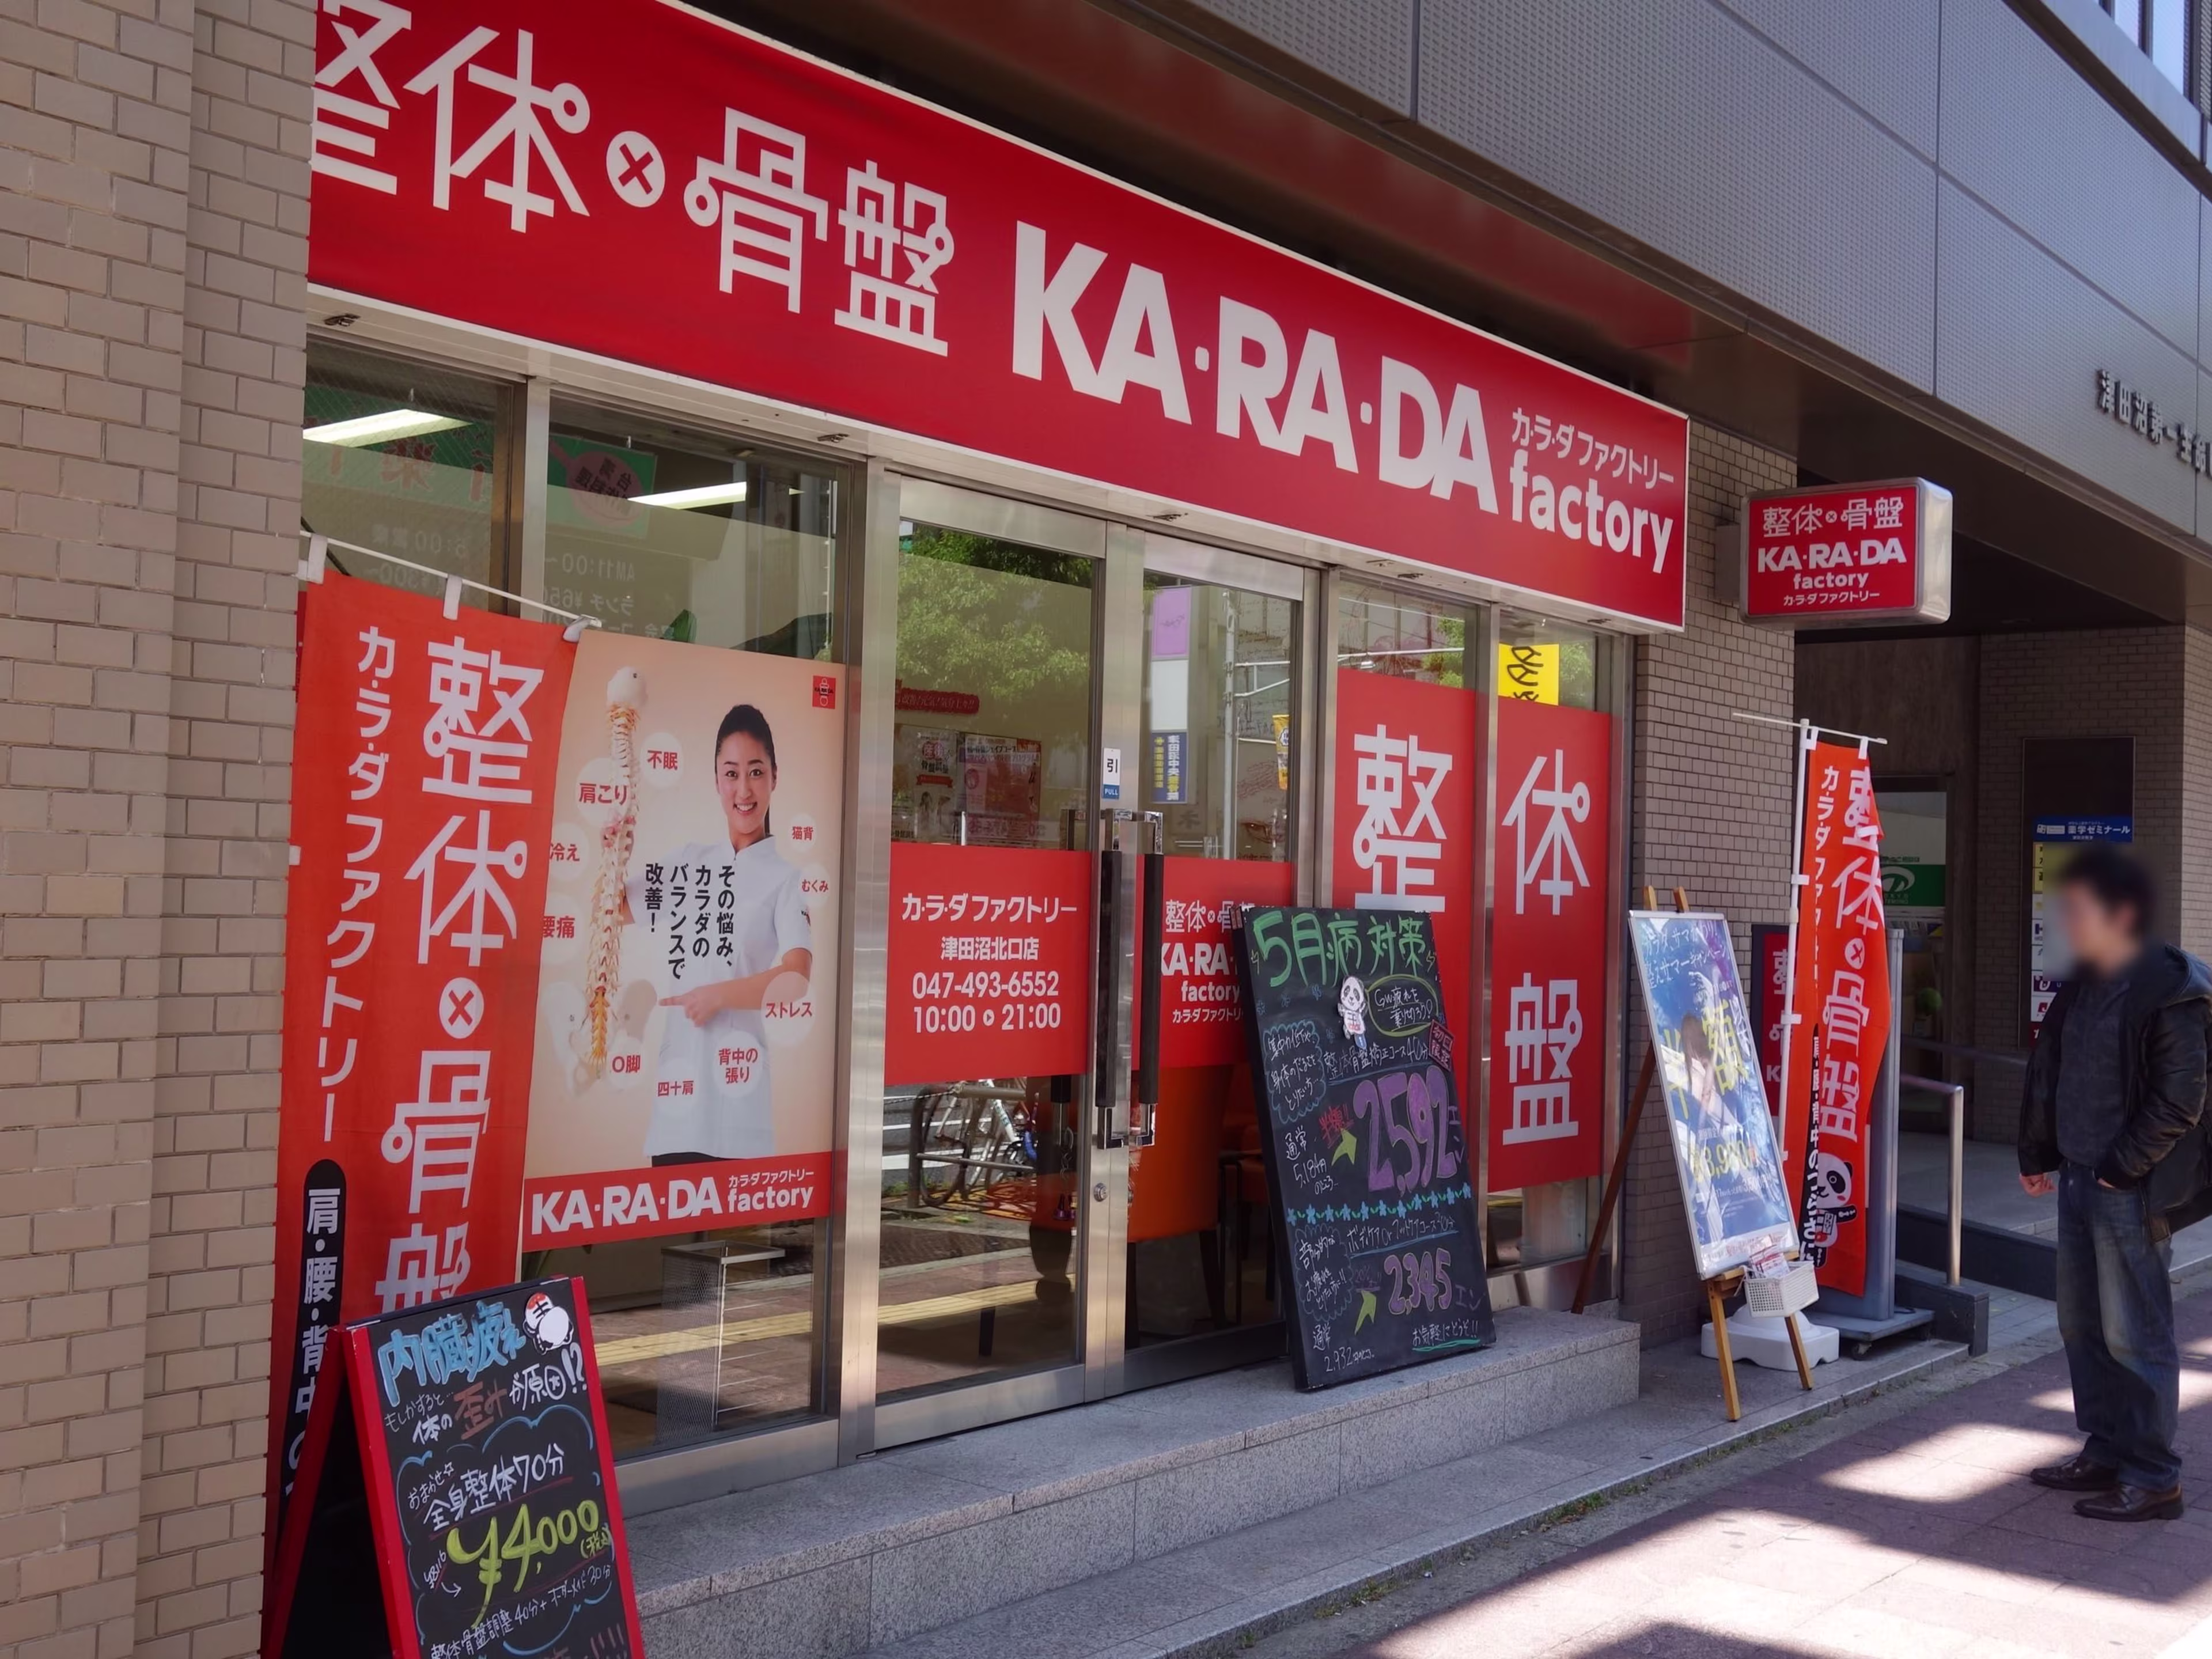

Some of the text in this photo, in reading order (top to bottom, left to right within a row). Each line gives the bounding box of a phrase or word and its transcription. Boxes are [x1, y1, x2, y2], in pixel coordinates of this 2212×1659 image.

[1510, 450, 1674, 574] factory
[1793, 572, 1869, 589] factory
[647, 750, 678, 770] 不眠
[1107, 758, 1118, 774] 引
[579, 783, 628, 804] 肩こり
[792, 826, 814, 841] 猫背
[550, 843, 580, 862] 冷え
[802, 879, 829, 893] むくみ
[668, 863, 689, 980] バランスで
[692, 865, 711, 958] カラダの
[542, 915, 575, 940] 腰痛
[941, 936, 1039, 961] 津田沼北口店
[1253, 910, 1426, 987] 5月病対策
[912, 971, 1059, 999] 047-493-6552
[1181, 981, 1240, 1003] factory
[766, 1002, 813, 1018] ストレス
[914, 1003, 1061, 1033] 10:00 21:00
[718, 1047, 759, 1066] 背中の
[725, 1066, 750, 1084] 張り
[657, 1080, 694, 1097] 四十肩
[728, 1184, 813, 1213] factory
[1383, 1247, 1453, 1316] 2,345
